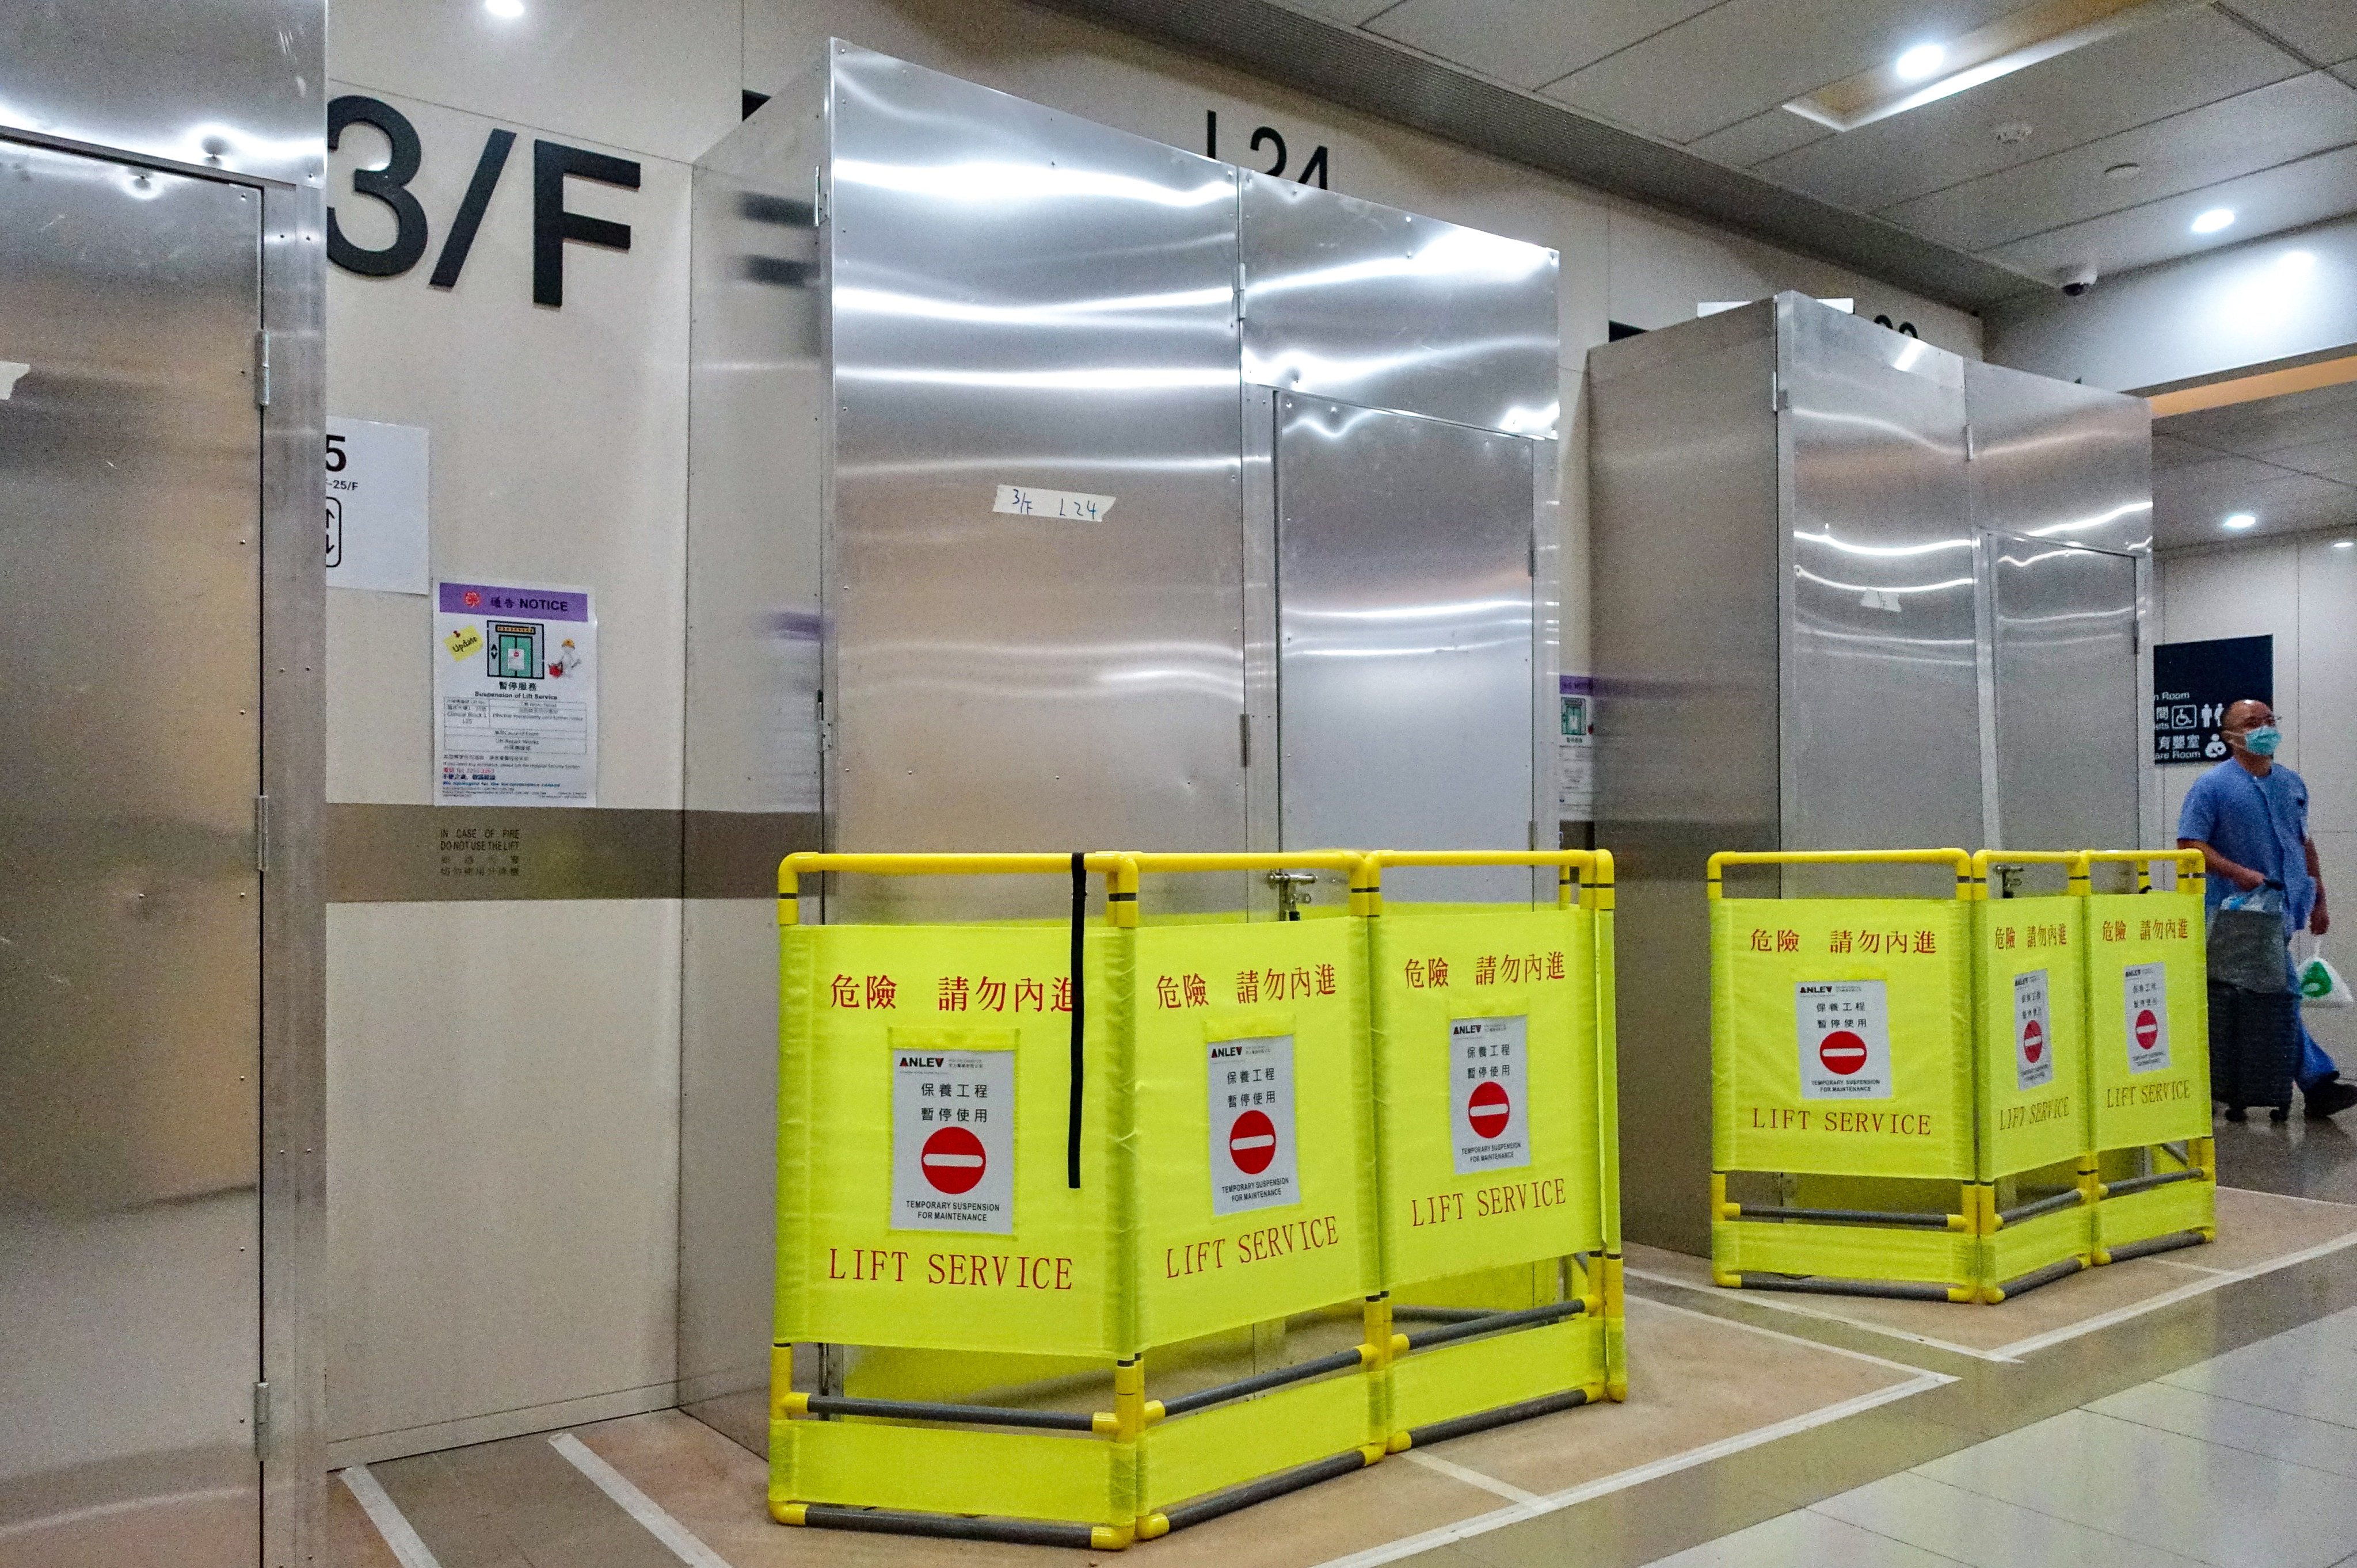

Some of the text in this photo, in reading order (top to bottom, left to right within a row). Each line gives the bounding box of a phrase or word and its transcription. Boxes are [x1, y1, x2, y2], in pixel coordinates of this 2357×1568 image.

[327, 96, 641, 307] 3/F
[1012, 489, 1033, 515] 3/F
[519, 598, 568, 611] NOTICE
[452, 636, 478, 653] Update
[499, 681, 536, 691] 暫停服務
[2162, 692, 2190, 700] Room
[2173, 750, 2200, 759] Room
[440, 829, 519, 839] IN CASE OF FIRE
[440, 841, 519, 850] DO NOT USE THE LIFT
[1995, 923, 2067, 950] 危險 請勿內進
[2103, 918, 2188, 941] 危險 請勿內進
[1750, 929, 1936, 955] 危險 請勿內進
[1404, 951, 1566, 989] 危險 請勿內進
[831, 974, 1072, 1012] 危險 請勿內進
[1156, 963, 1336, 1010] 危險 請勿內進
[1799, 986, 1833, 994] ANLEV
[1817, 1001, 1865, 1012] 保養工程
[1453, 1024, 1482, 1035] ANLEV
[1817, 1018, 1867, 1029] 暫停使用
[1211, 1046, 1243, 1058] ANLEV
[1467, 1044, 1510, 1058] 保養工程
[899, 1057, 944, 1067] ANLEV
[1227, 1067, 1275, 1085] 保養工程
[1468, 1065, 1510, 1079] 暫停使用
[921, 1083, 988, 1098] 保養工程
[2107, 1080, 2190, 1108] LIFT SERVICE
[1228, 1090, 1275, 1108] 暫停使用
[921, 1107, 987, 1123] 暫停使用
[2000, 1096, 2069, 1131] LIFT SERVICE
[1753, 1108, 1931, 1135] LIFT SERVICE
[1461, 1142, 1521, 1155] TEMPORARY SUSPENSION
[1481, 1151, 1514, 1161] MAINTENANCE
[1221, 1177, 1289, 1194] TEMPORARY SUSPENSION
[1231, 1188, 1282, 1202] FOR MAINTENANCE
[1412, 1178, 1566, 1227] LIFT SERVICE
[907, 1200, 1000, 1211] TEMPORARY SUSPENSION
[917, 1211, 987, 1221] FOR MAINTENANCE
[1167, 1215, 1338, 1279] LIFT SERVICE
[829, 1248, 1072, 1290] LIFT SERVICE
